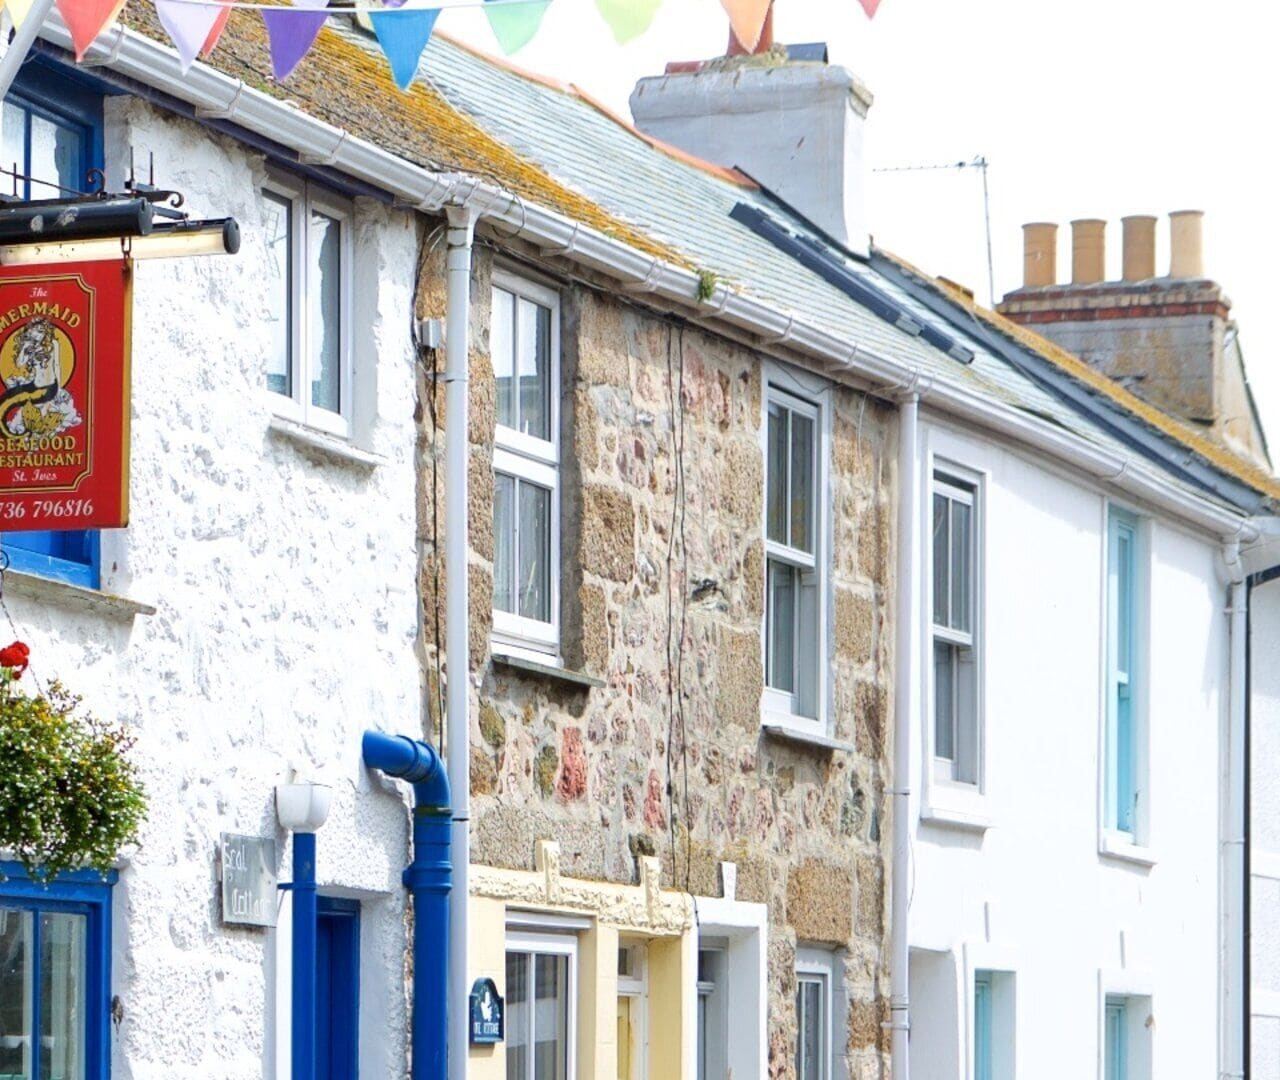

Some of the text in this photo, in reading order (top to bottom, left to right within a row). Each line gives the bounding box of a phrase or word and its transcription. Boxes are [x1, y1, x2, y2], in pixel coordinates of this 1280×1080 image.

[29, 287, 49, 298] The
[12, 469, 58, 482] St. Ives
[32, 498, 94, 518] 796816
